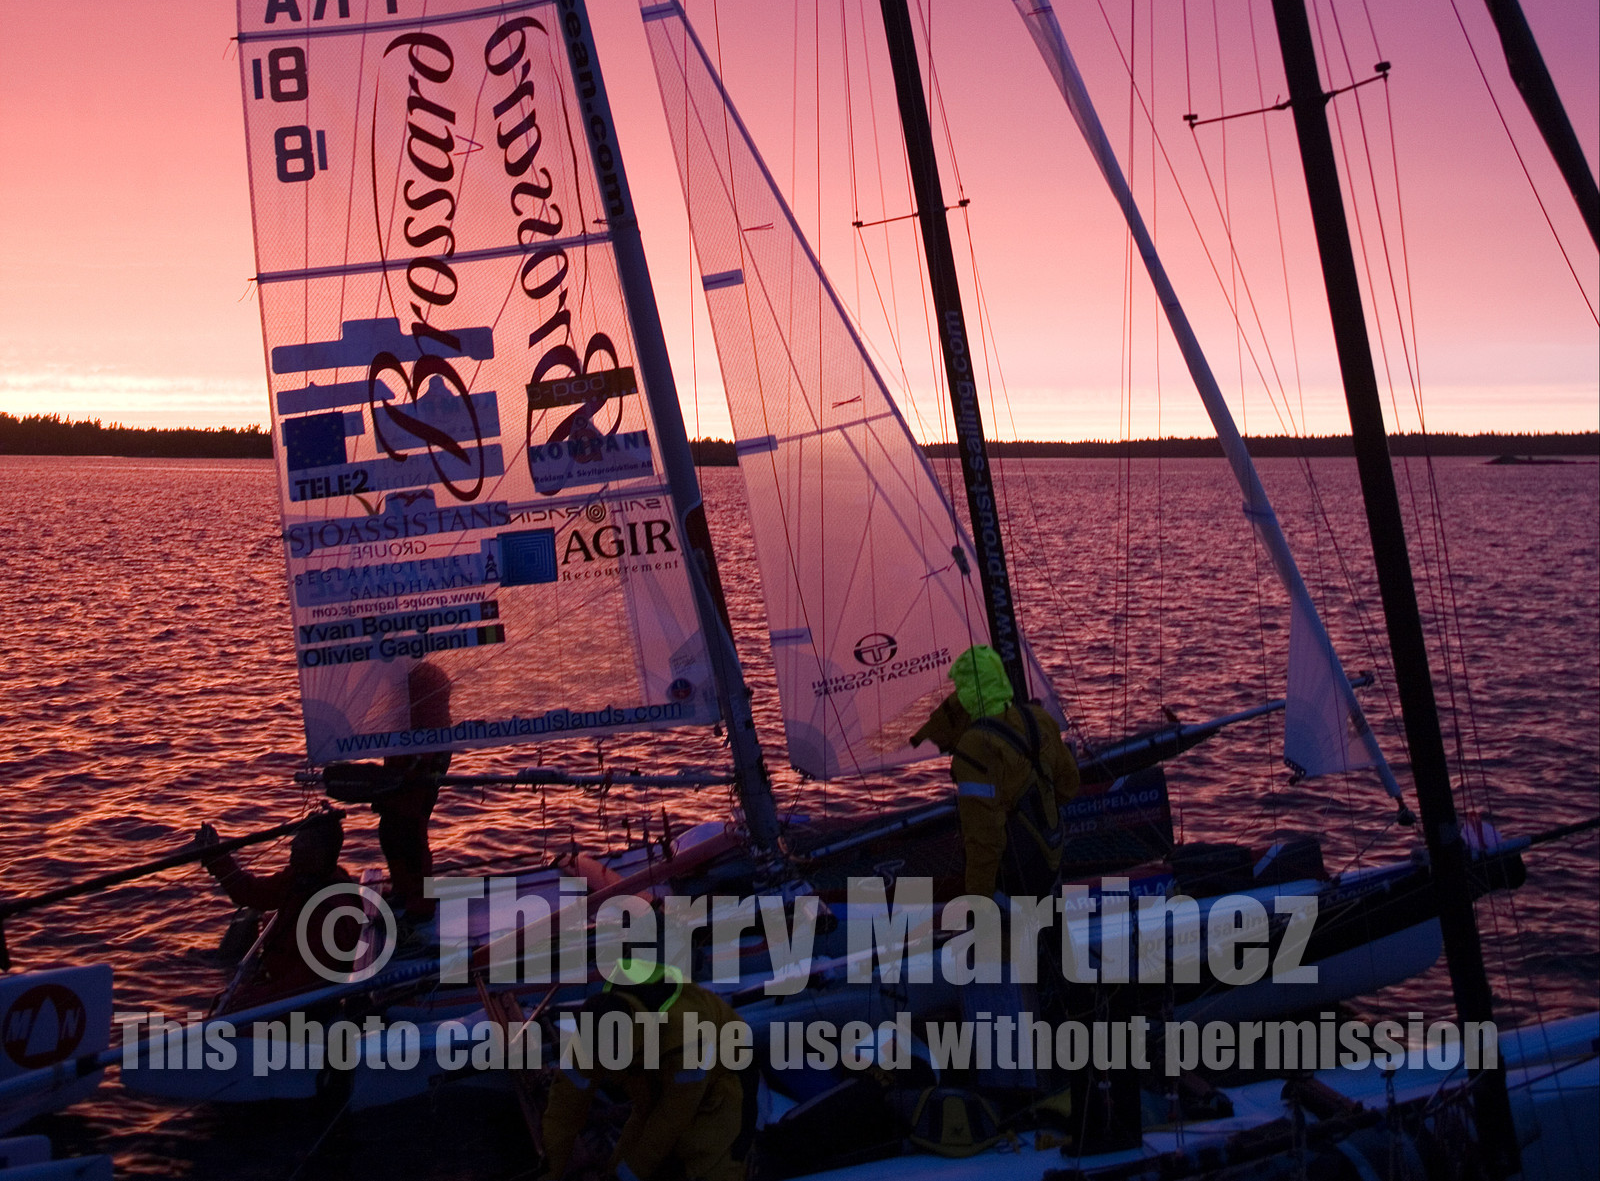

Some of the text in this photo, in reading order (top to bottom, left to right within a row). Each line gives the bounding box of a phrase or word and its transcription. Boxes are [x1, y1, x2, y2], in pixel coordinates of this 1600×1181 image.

[253, 47, 308, 102] 18
[369, 33, 483, 501] Brossard
[294, 470, 370, 501] TELE2
[946, 310, 1015, 662] www.proust-sailing.com
[289, 501, 511, 556] SJÖASSISTANS
[561, 519, 677, 566] AGIR
[295, 553, 472, 586] SEGLARHOTELLET
[350, 572, 474, 601] SANDHAMN
[563, 560, 679, 582] Recouvrement
[300, 607, 472, 644] Yvan Bourgnon
[303, 629, 469, 668] Olivier Gagliani
[814, 655, 952, 698] SERGIO TACCHINI
[336, 702, 682, 753] www.scandinavianislands.com
